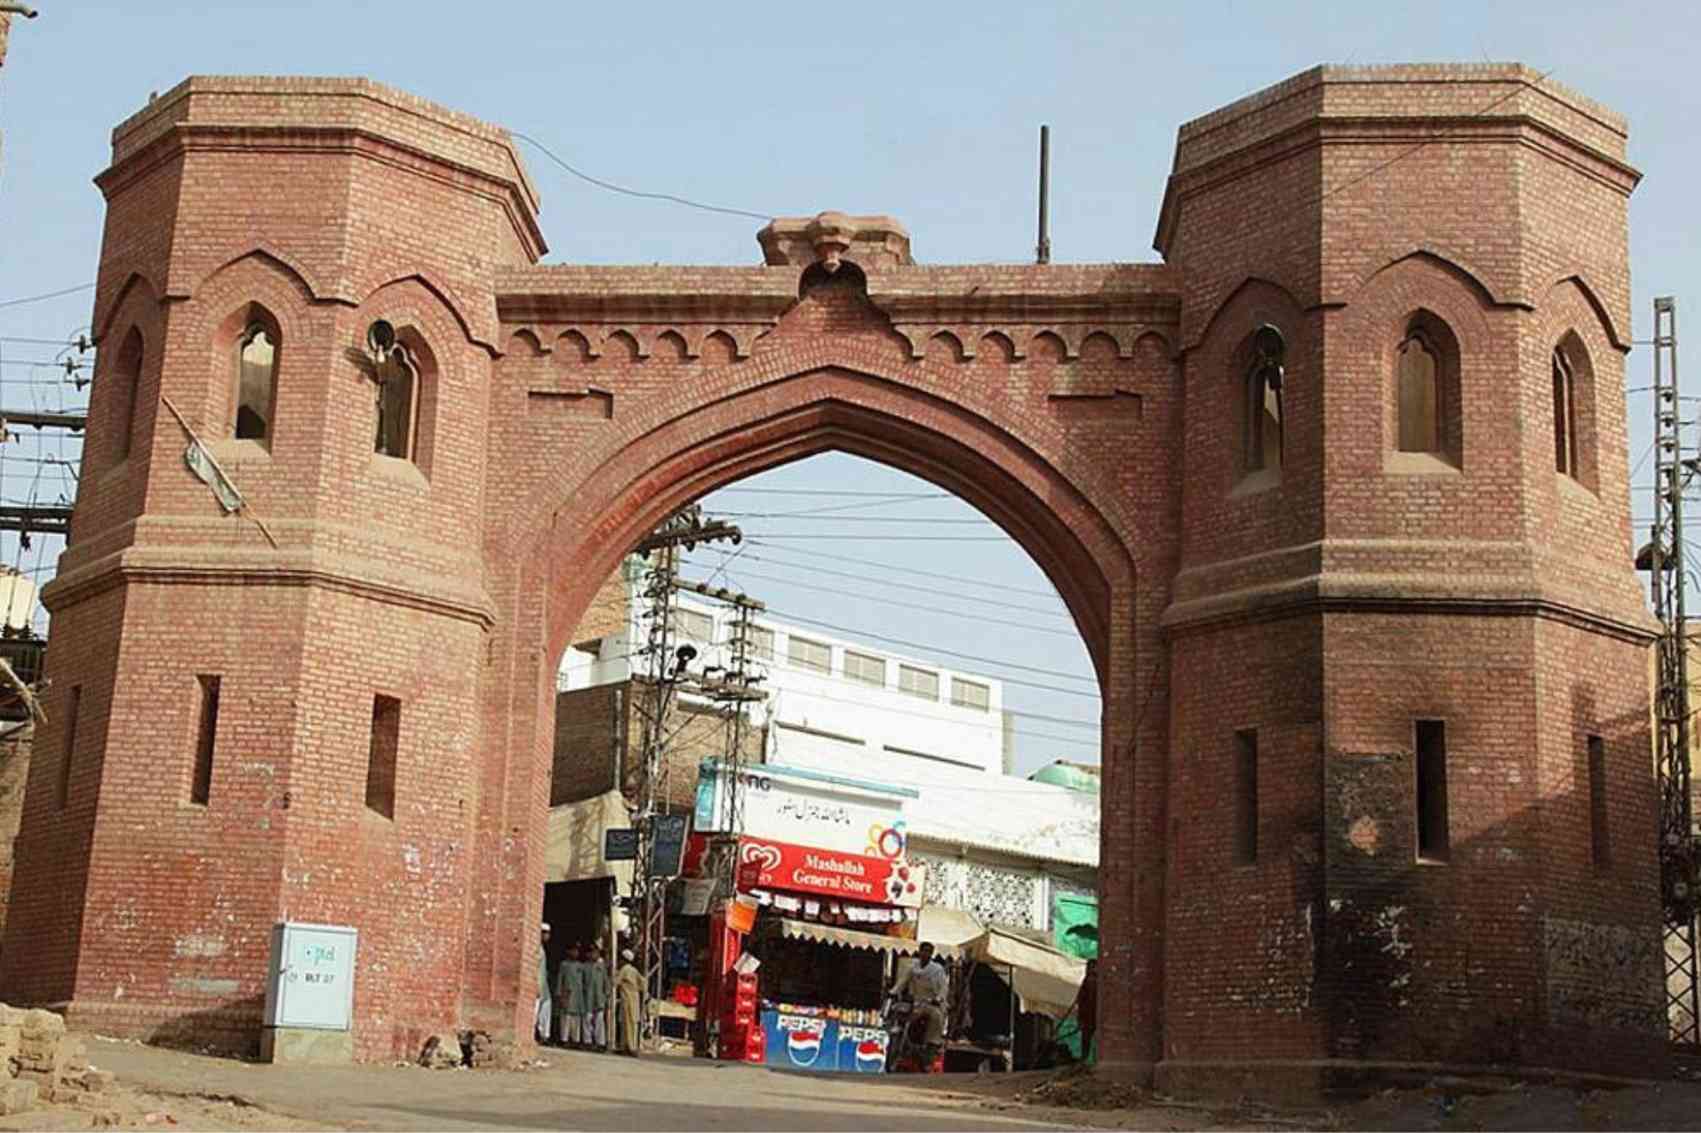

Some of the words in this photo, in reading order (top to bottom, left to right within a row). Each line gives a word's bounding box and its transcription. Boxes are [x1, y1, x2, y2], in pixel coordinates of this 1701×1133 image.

[803, 854, 865, 876] Mashallah
[792, 868, 841, 888] General
[842, 876, 873, 894] Store
